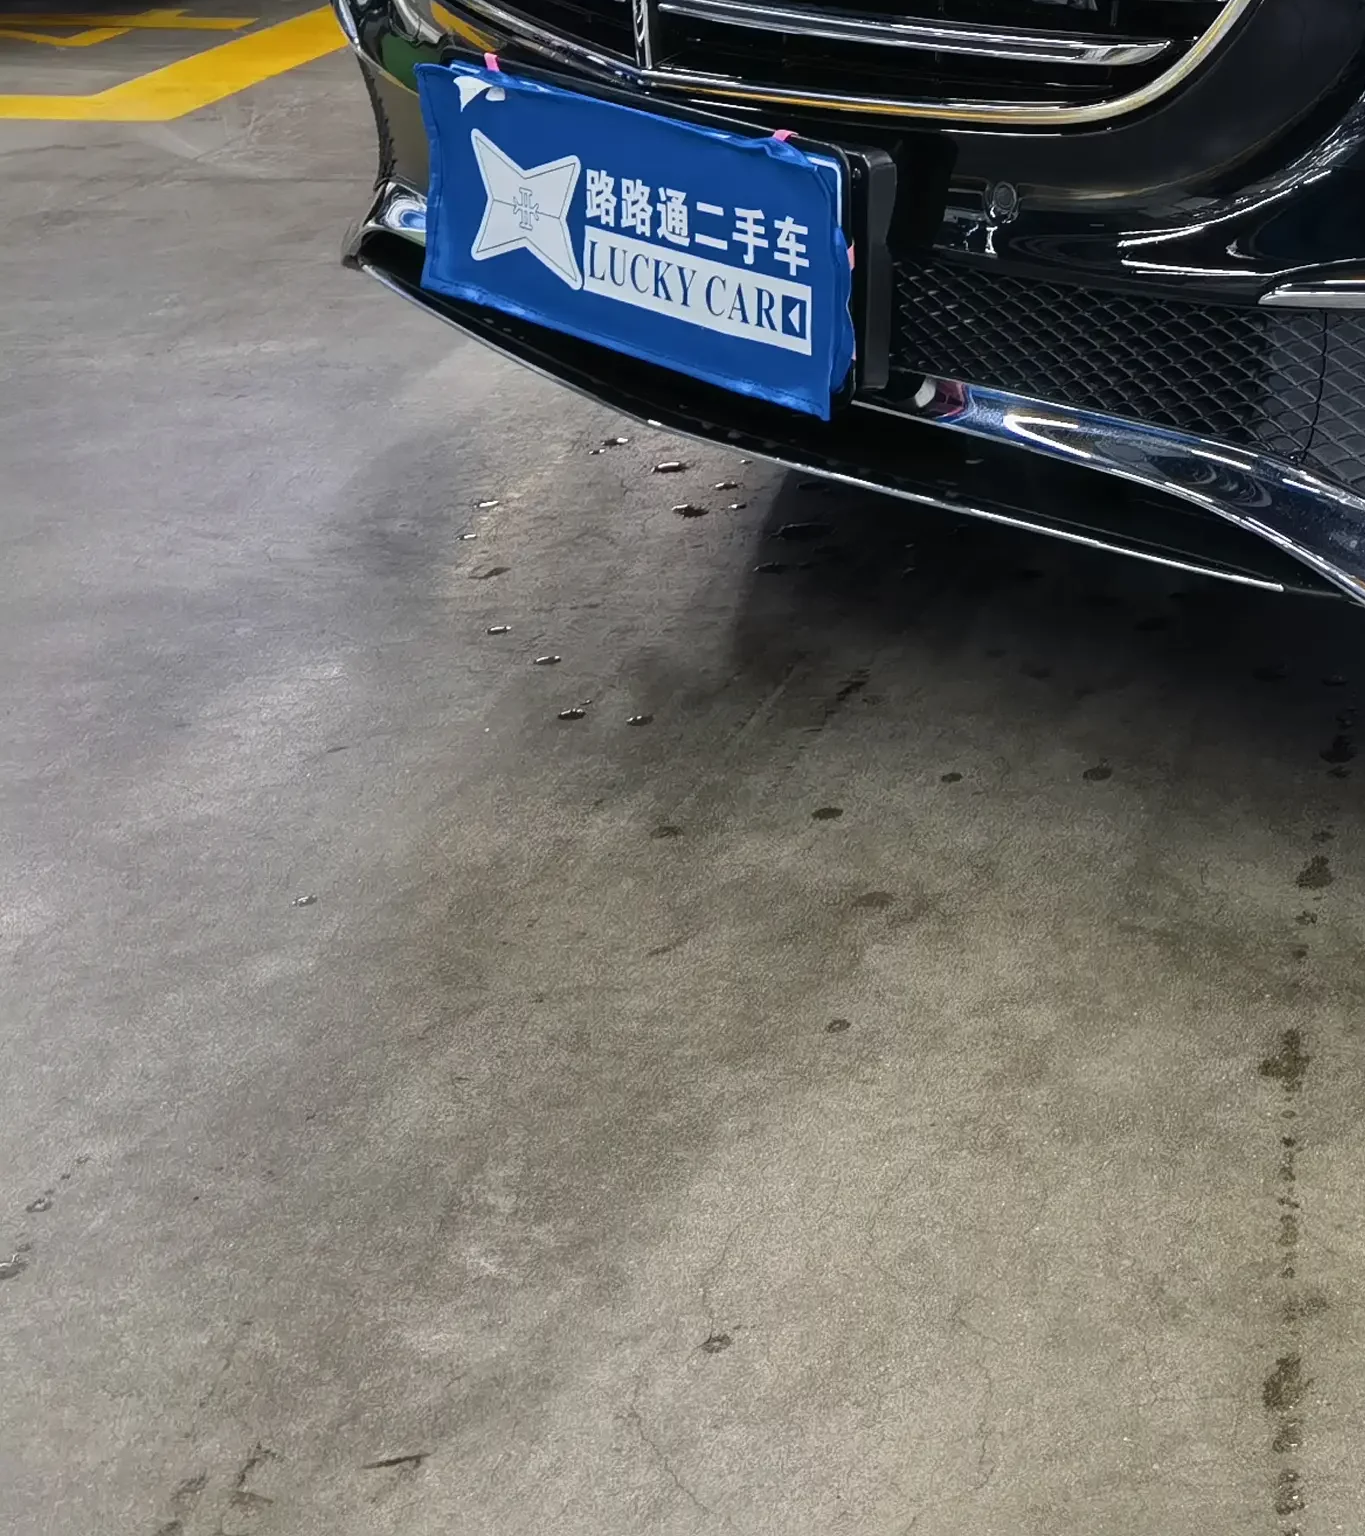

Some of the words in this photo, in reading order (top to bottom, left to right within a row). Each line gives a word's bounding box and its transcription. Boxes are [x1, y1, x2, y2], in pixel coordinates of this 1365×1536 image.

[585, 168, 810, 276] 路路通二手车
[588, 239, 697, 308] LUCKY
[705, 275, 778, 332] CAR
